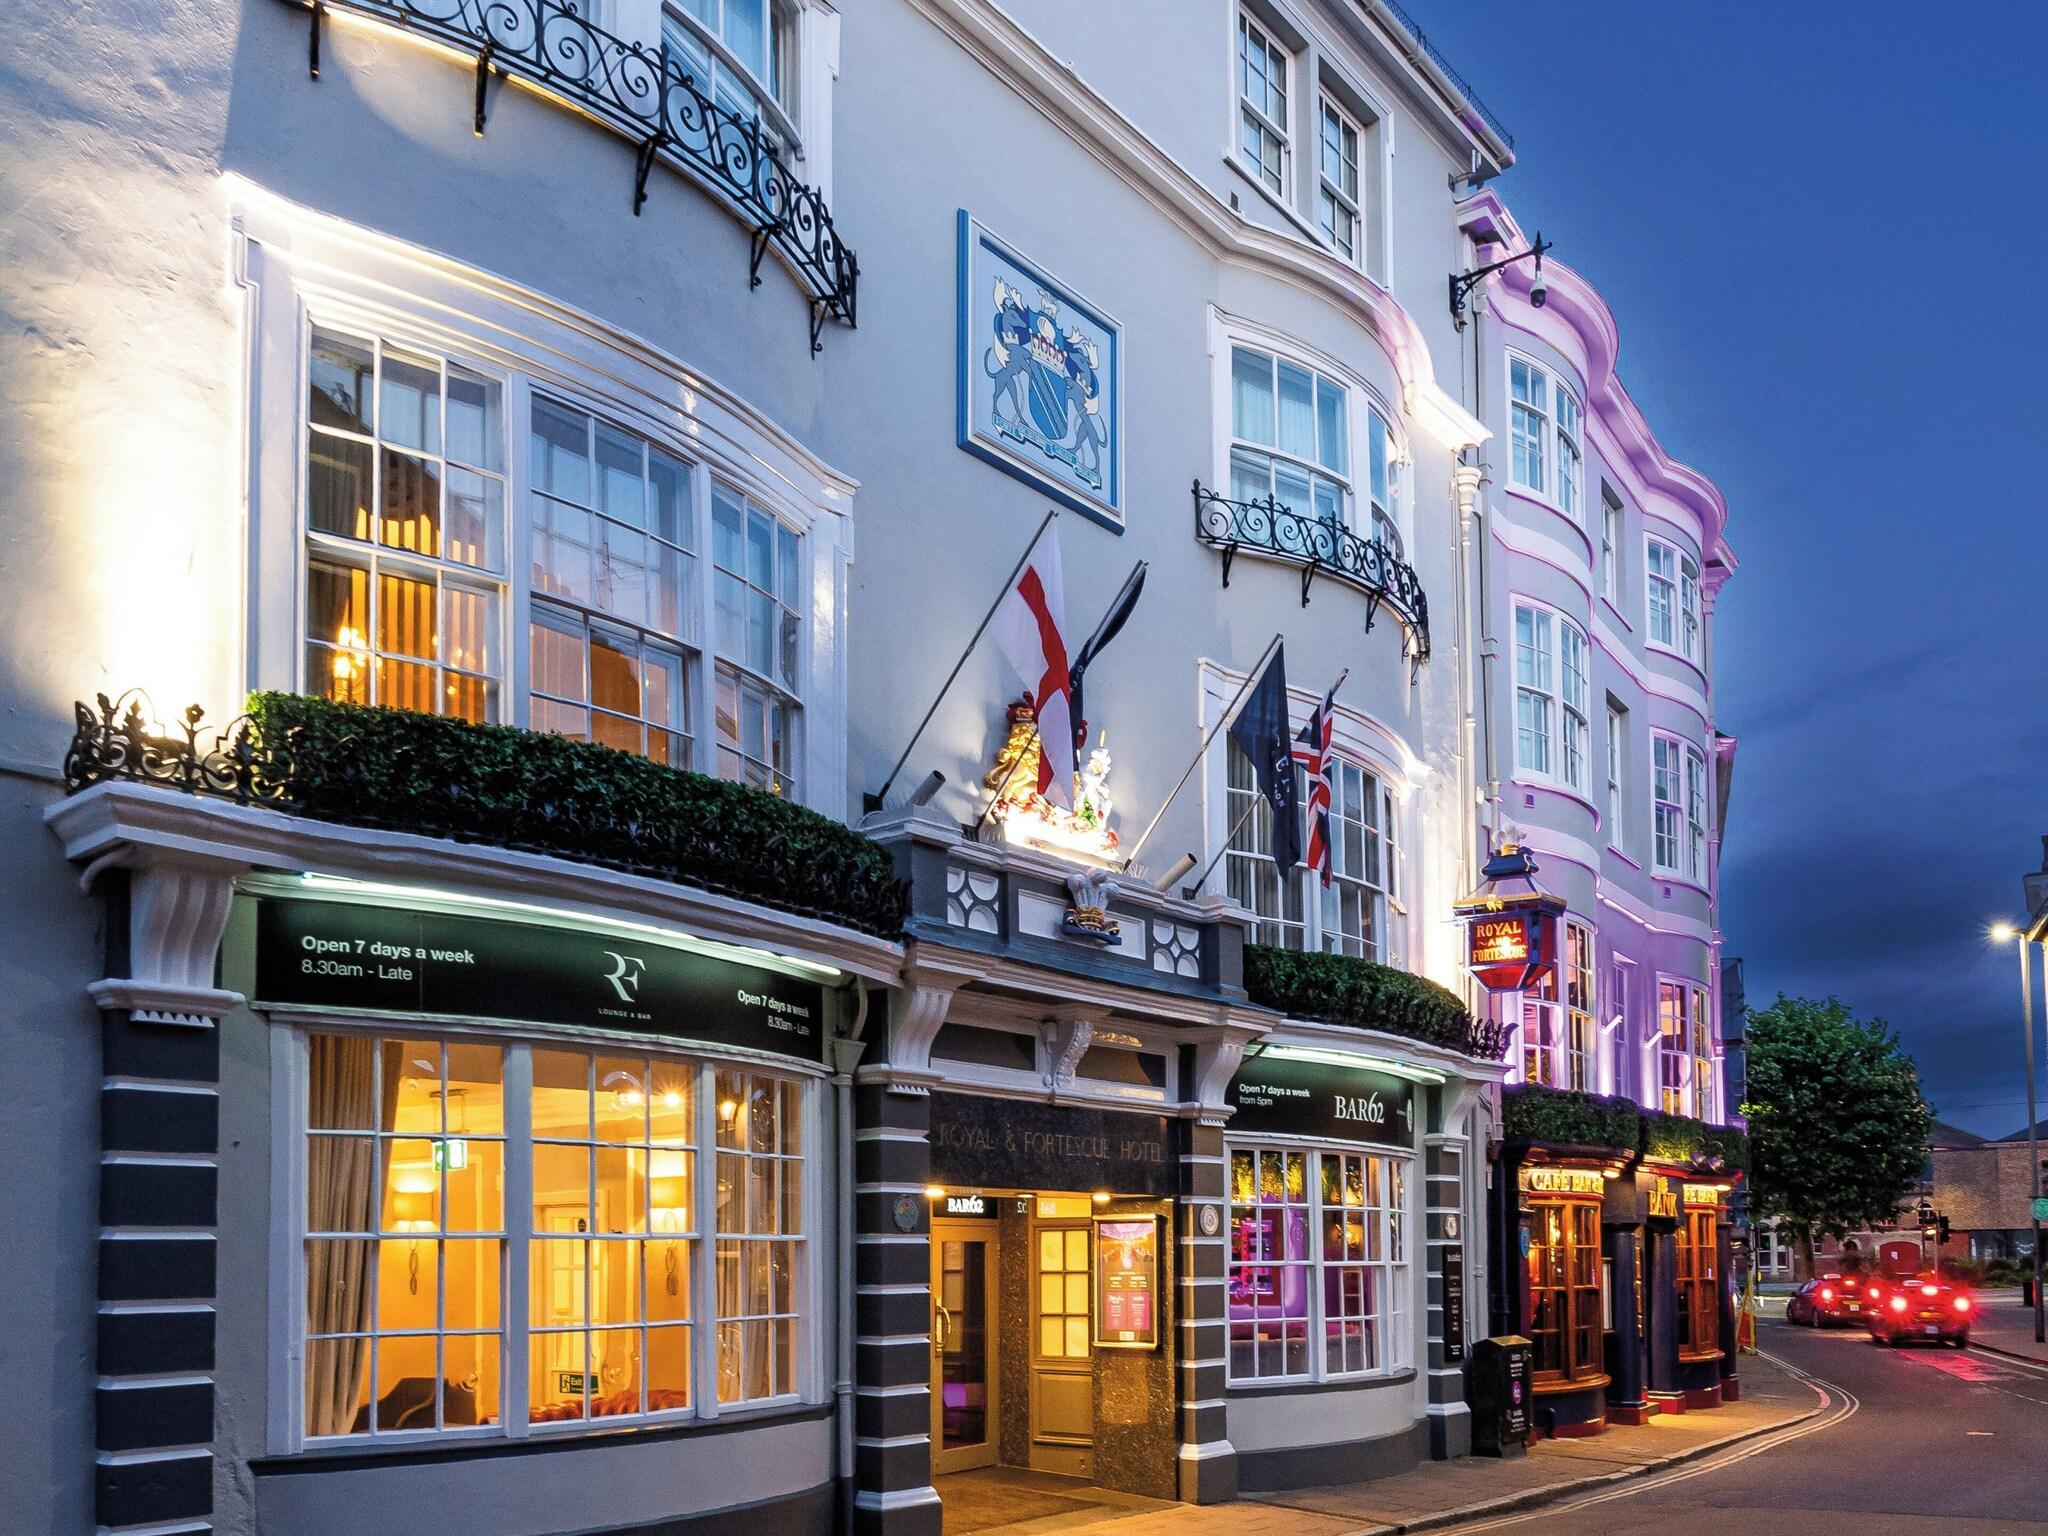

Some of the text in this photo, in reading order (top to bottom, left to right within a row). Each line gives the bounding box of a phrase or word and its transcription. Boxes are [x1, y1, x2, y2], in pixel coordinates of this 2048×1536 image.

[1476, 921, 1522, 938] ROYAL
[301, 935, 475, 964] Open 7 days a week
[301, 959, 363, 976] 8.30am
[378, 964, 413, 981] Late
[598, 1007, 628, 1018] LOUNGE
[637, 1012, 652, 1020] BAR
[737, 989, 810, 1018] Open 7 days a week
[1239, 1083, 1311, 1098] Open 7 days a week
[1239, 1096, 1273, 1107] from 5pm
[1334, 1091, 1385, 1124] BAR62
[939, 1123, 1165, 1163] ROYAL & FORTESCUE HOTEL
[947, 1194, 984, 1214] BAR62
[1648, 1191, 1679, 1217] BANK
